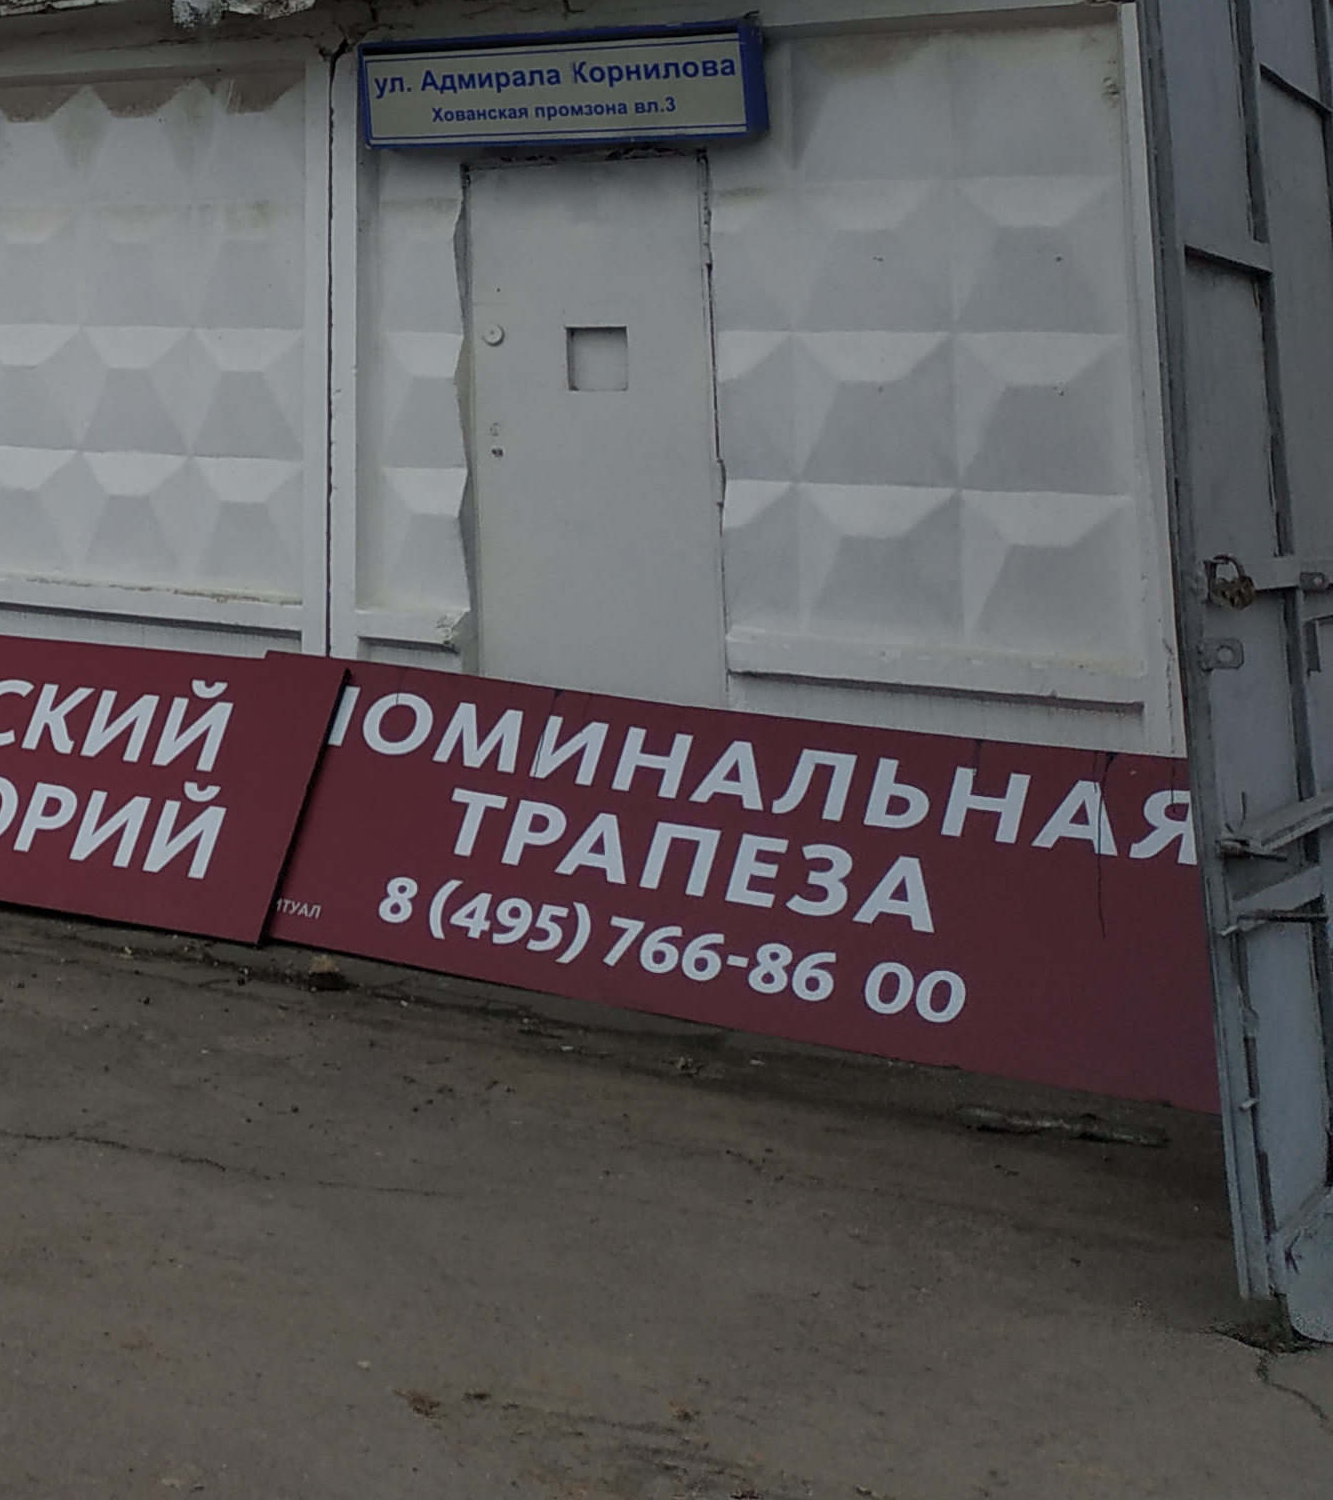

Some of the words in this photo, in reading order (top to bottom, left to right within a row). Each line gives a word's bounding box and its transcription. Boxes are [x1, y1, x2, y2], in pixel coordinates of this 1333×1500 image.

[374, 71, 412, 99] ул.
[421, 67, 562, 94] Адмирала
[571, 56, 736, 87] Корнилова
[432, 105, 529, 123] Хованская
[535, 101, 629, 121] промзона
[634, 96, 677, 115] вл.3
[450, 788, 936, 934] ТРАПЕЗА
[276, 897, 322, 921] ТУАЛ
[377, 875, 414, 924] 8
[428, 878, 593, 965] (495)
[602, 915, 836, 1003] 766-86
[864, 969, 966, 1025] 00
